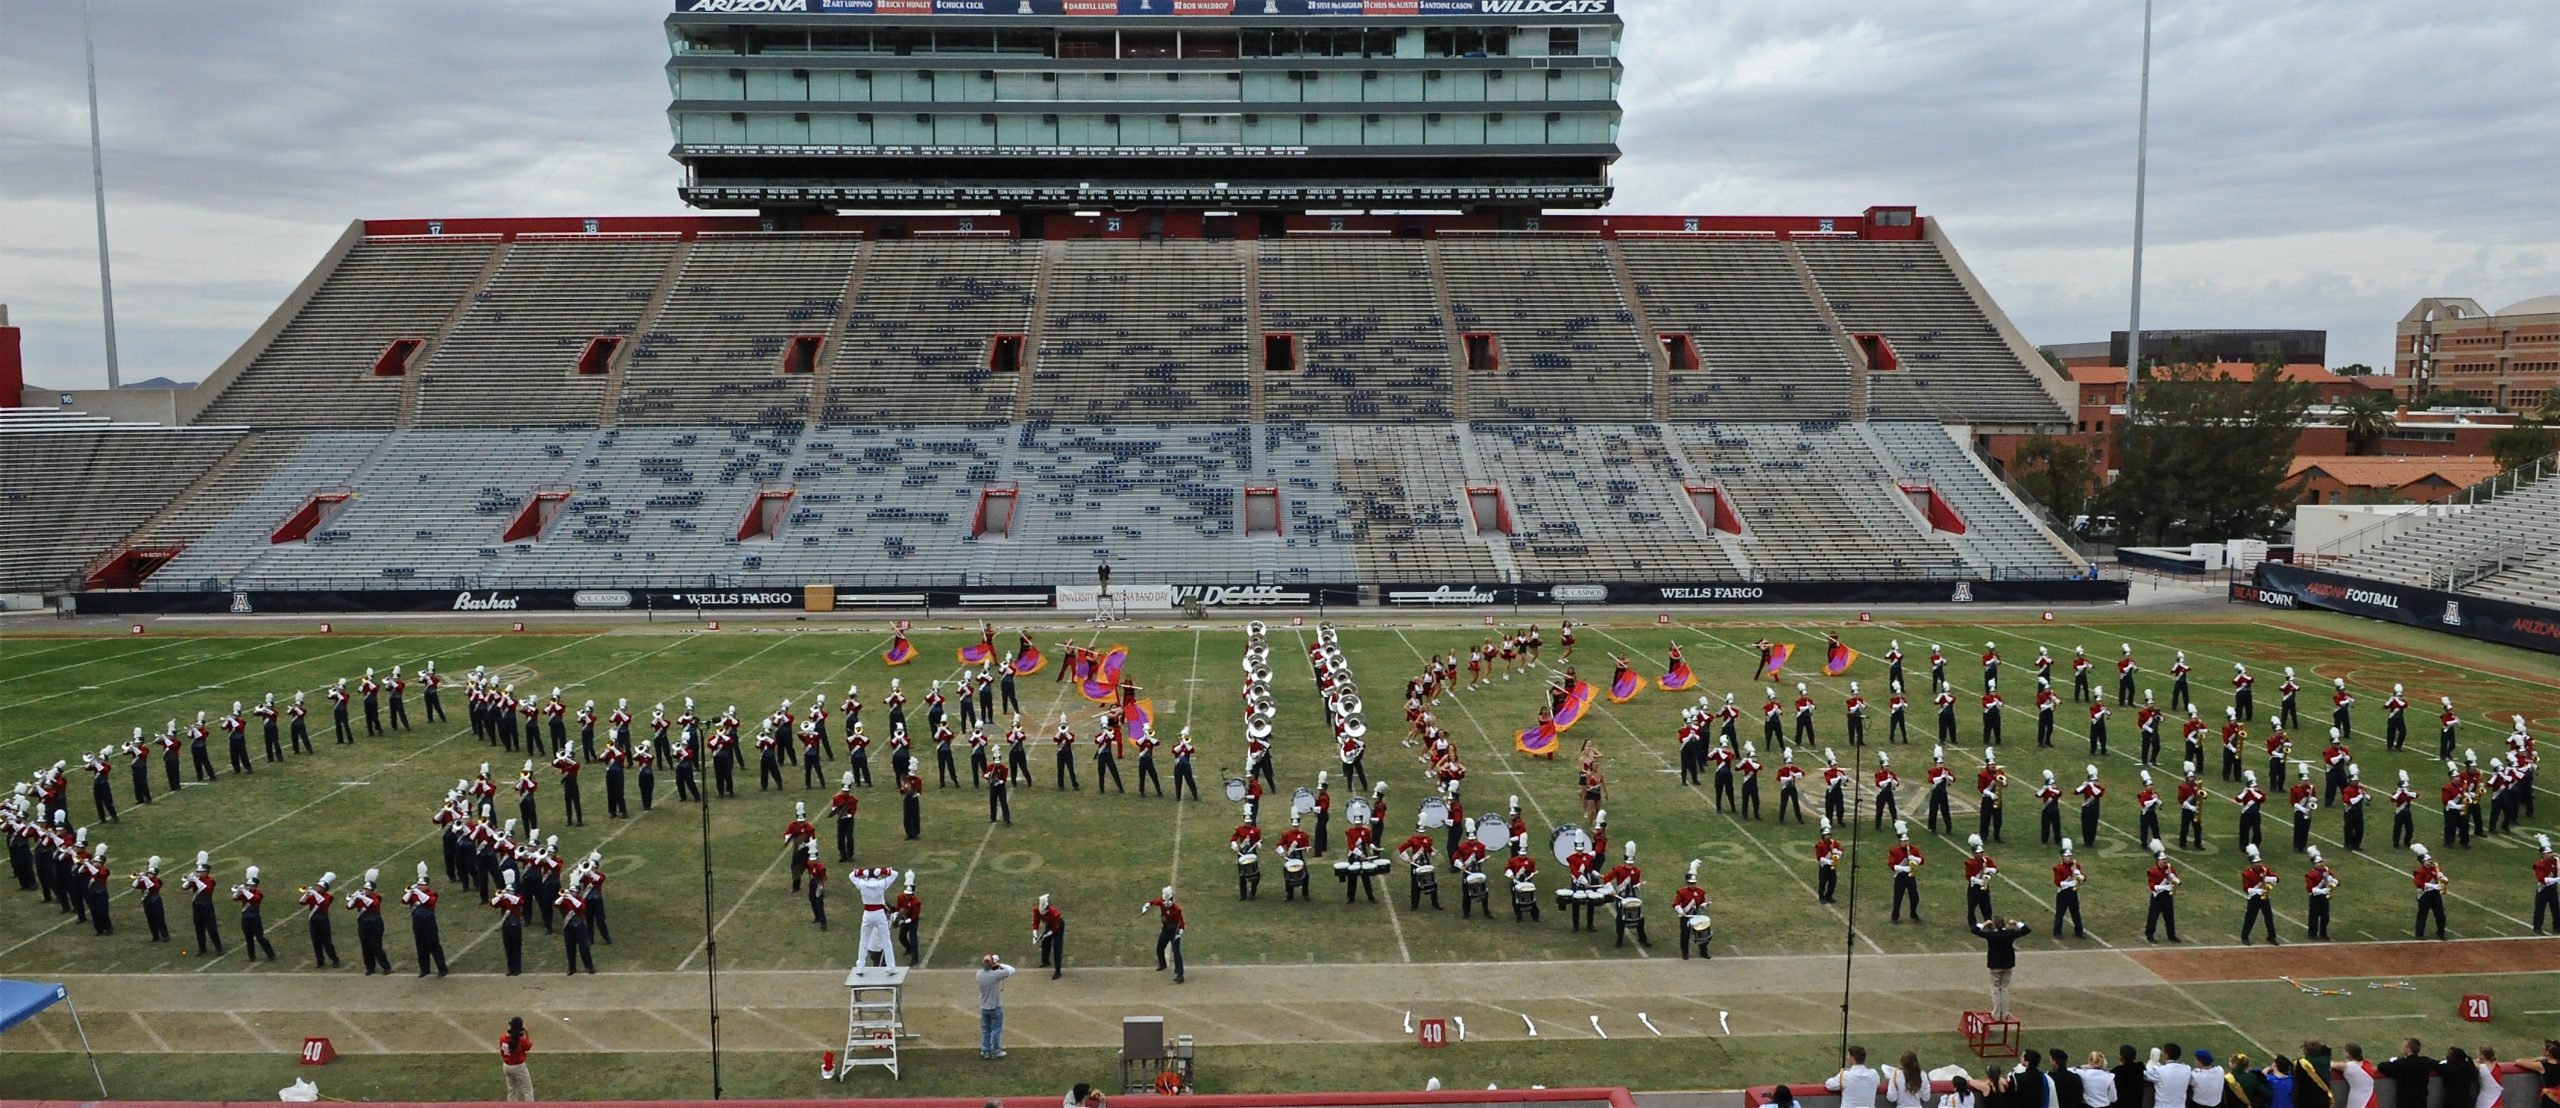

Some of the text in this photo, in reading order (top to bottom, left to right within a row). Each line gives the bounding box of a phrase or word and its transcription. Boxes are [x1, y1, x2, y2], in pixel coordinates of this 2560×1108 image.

[688, 0, 807, 11] ARIZONA
[942, 1, 965, 9] CHUCK
[966, 1, 984, 9] CECIL
[1481, 0, 1607, 13] WILDCATS
[430, 225, 441, 234] 17
[584, 224, 597, 233] 18
[762, 222, 773, 233] 19
[959, 221, 973, 231] 20
[1108, 221, 1120, 231] 21
[1330, 221, 1343, 231] 22
[1526, 221, 1539, 231] 23
[1685, 222, 1697, 232] 24
[1820, 223, 1832, 233] 25
[62, 395, 72, 404] 16
[686, 593, 792, 604] WELLS FARGO
[1059, 592, 1094, 602] UNIVERSITY
[1136, 592, 1154, 602] BAND
[1155, 592, 1169, 602] DAY
[1660, 588, 1763, 599] WELLS FARGO
[2259, 590, 2292, 607] DOWN
[2345, 588, 2399, 608] FOOTBALL
[453, 591, 519, 610] Bashas'
[2468, 999, 2488, 1018] 20
[1423, 1023, 1441, 1043] 40
[303, 1041, 322, 1061] 40
